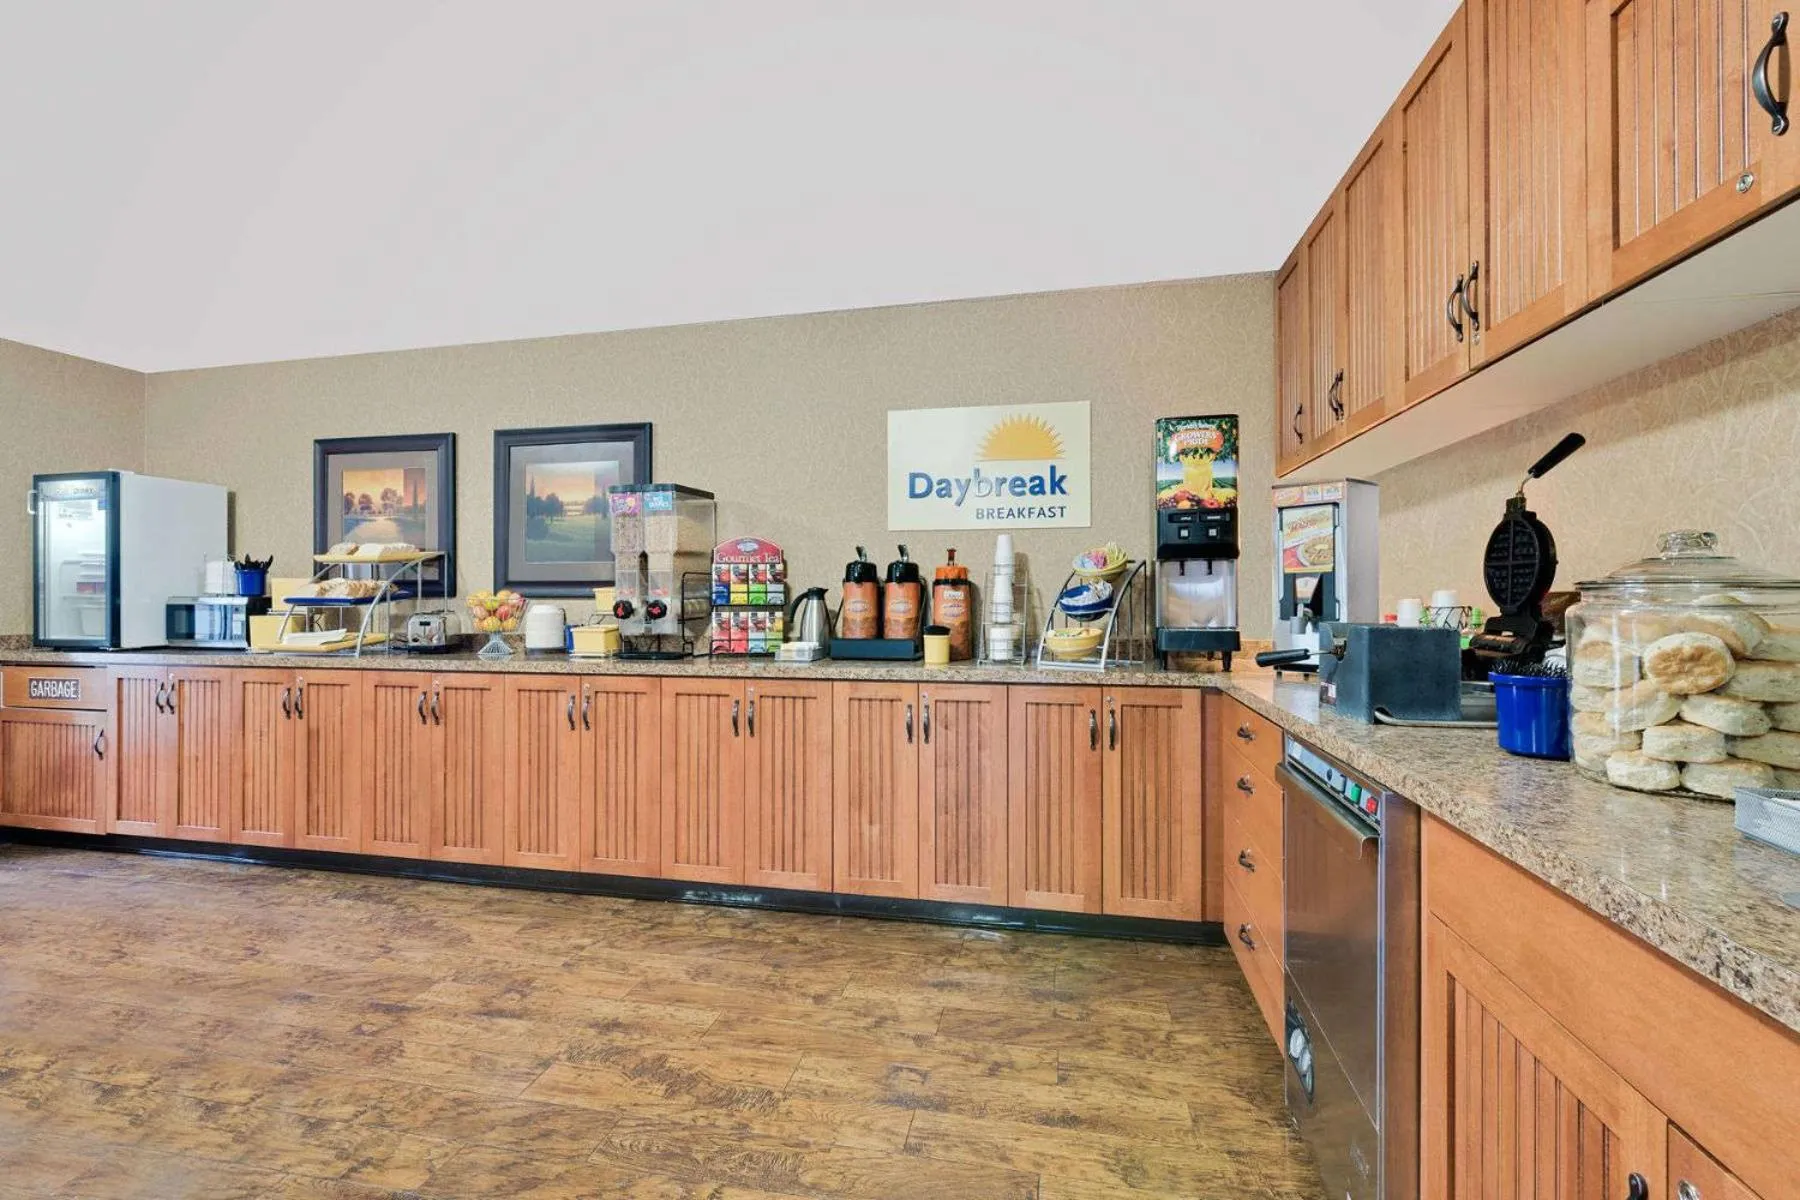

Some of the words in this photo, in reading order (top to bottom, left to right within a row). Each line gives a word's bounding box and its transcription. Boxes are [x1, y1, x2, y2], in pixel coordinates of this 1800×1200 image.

[908, 465, 1068, 507] Daybreak
[976, 506, 1067, 520] BREAKFAST
[717, 551, 761, 564] Gourmet
[763, 551, 780, 563] Tea
[30, 680, 78, 698] GARBAGE
